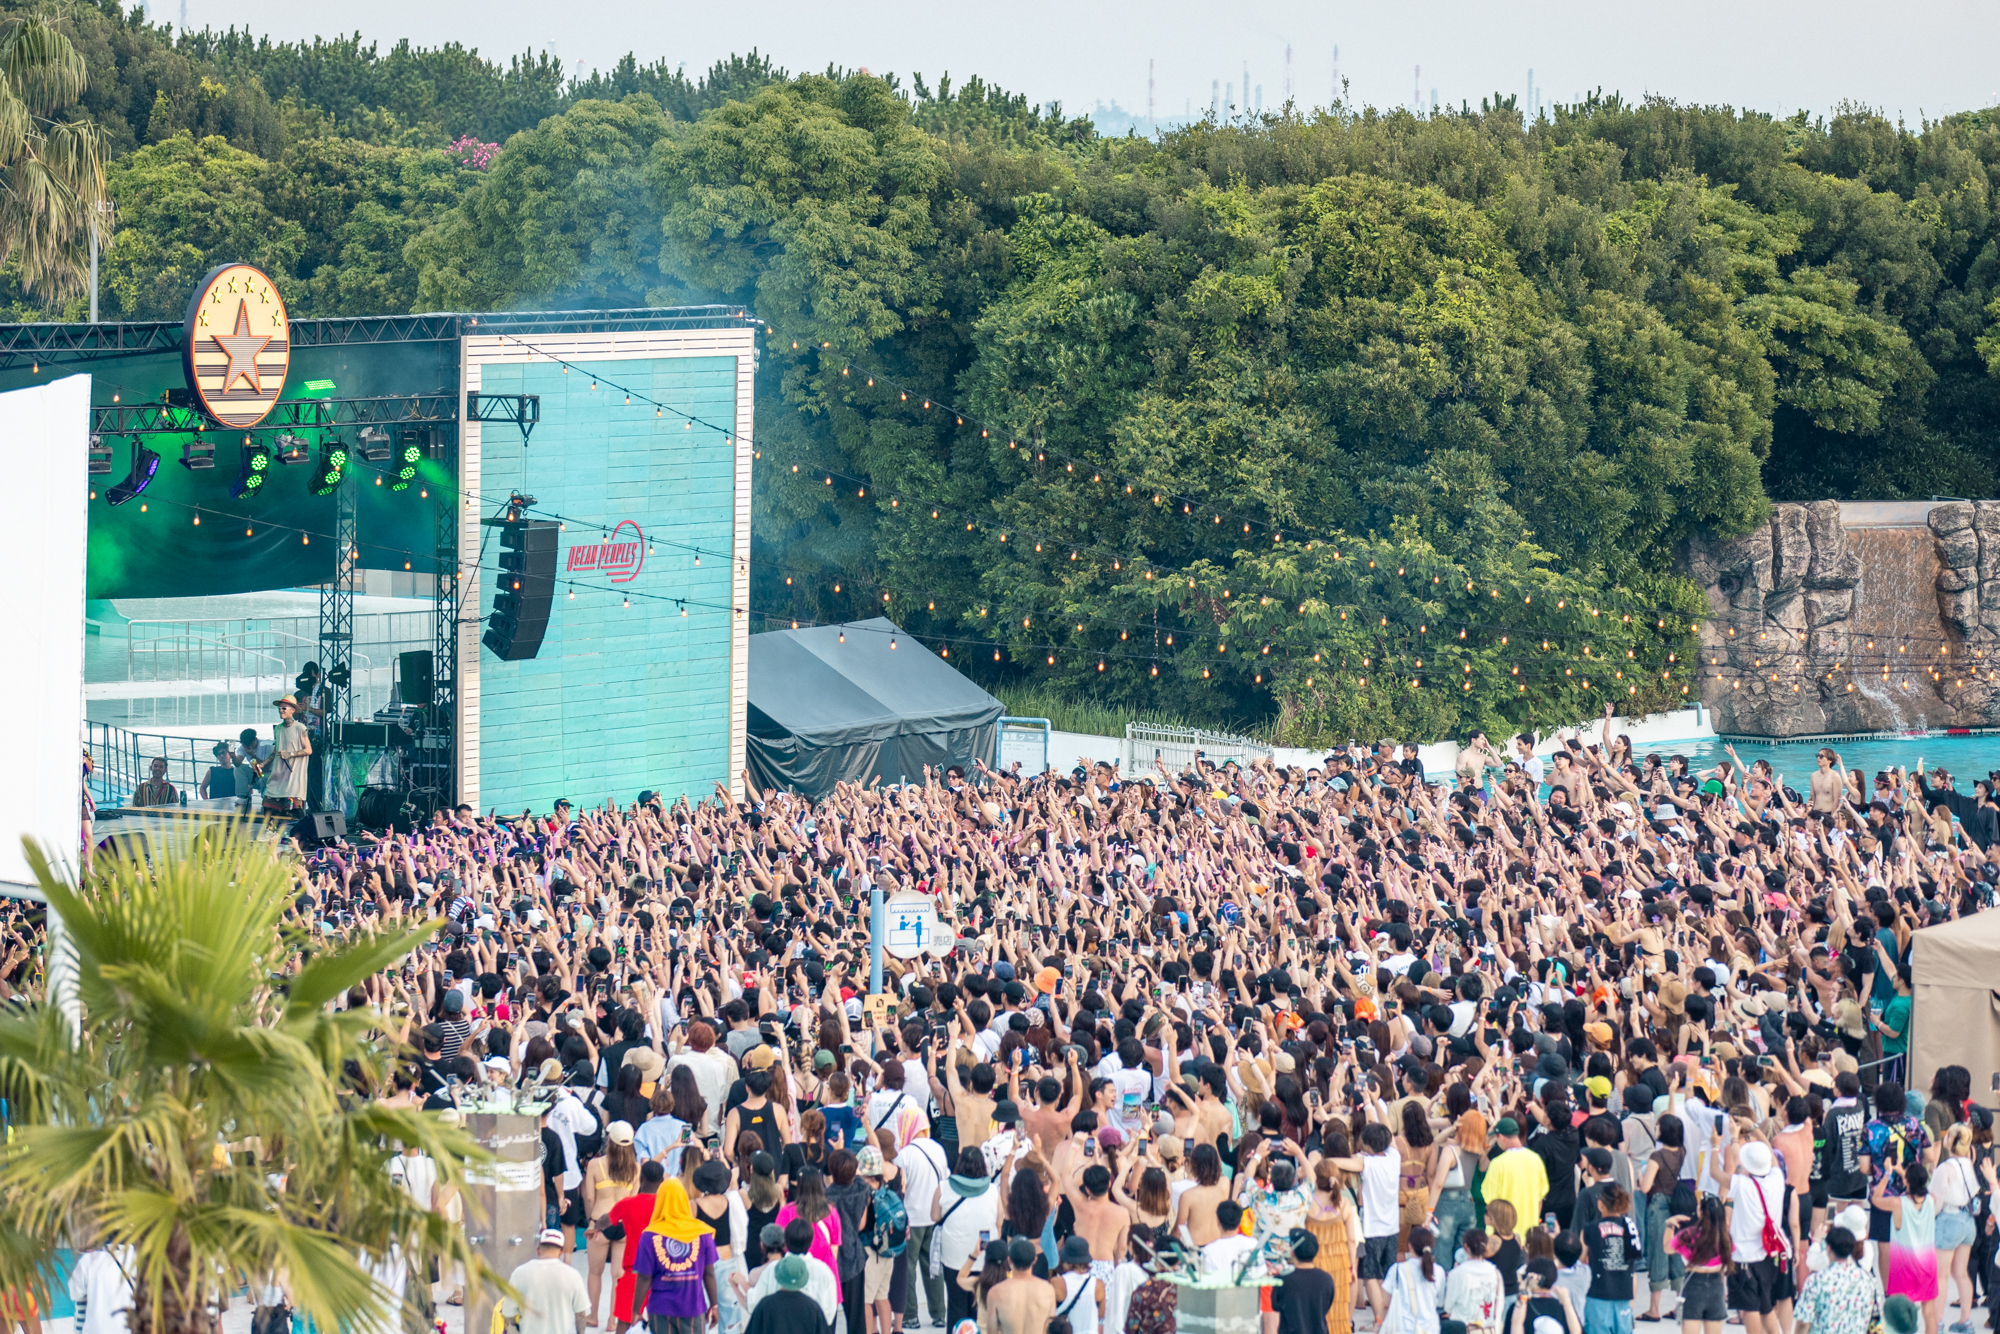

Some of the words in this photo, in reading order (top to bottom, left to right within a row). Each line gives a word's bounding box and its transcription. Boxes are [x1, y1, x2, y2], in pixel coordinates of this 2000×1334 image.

[567, 546, 599, 572] OCEAN
[597, 542, 638, 570] PEOPLES
[933, 935, 952, 946] 売店
